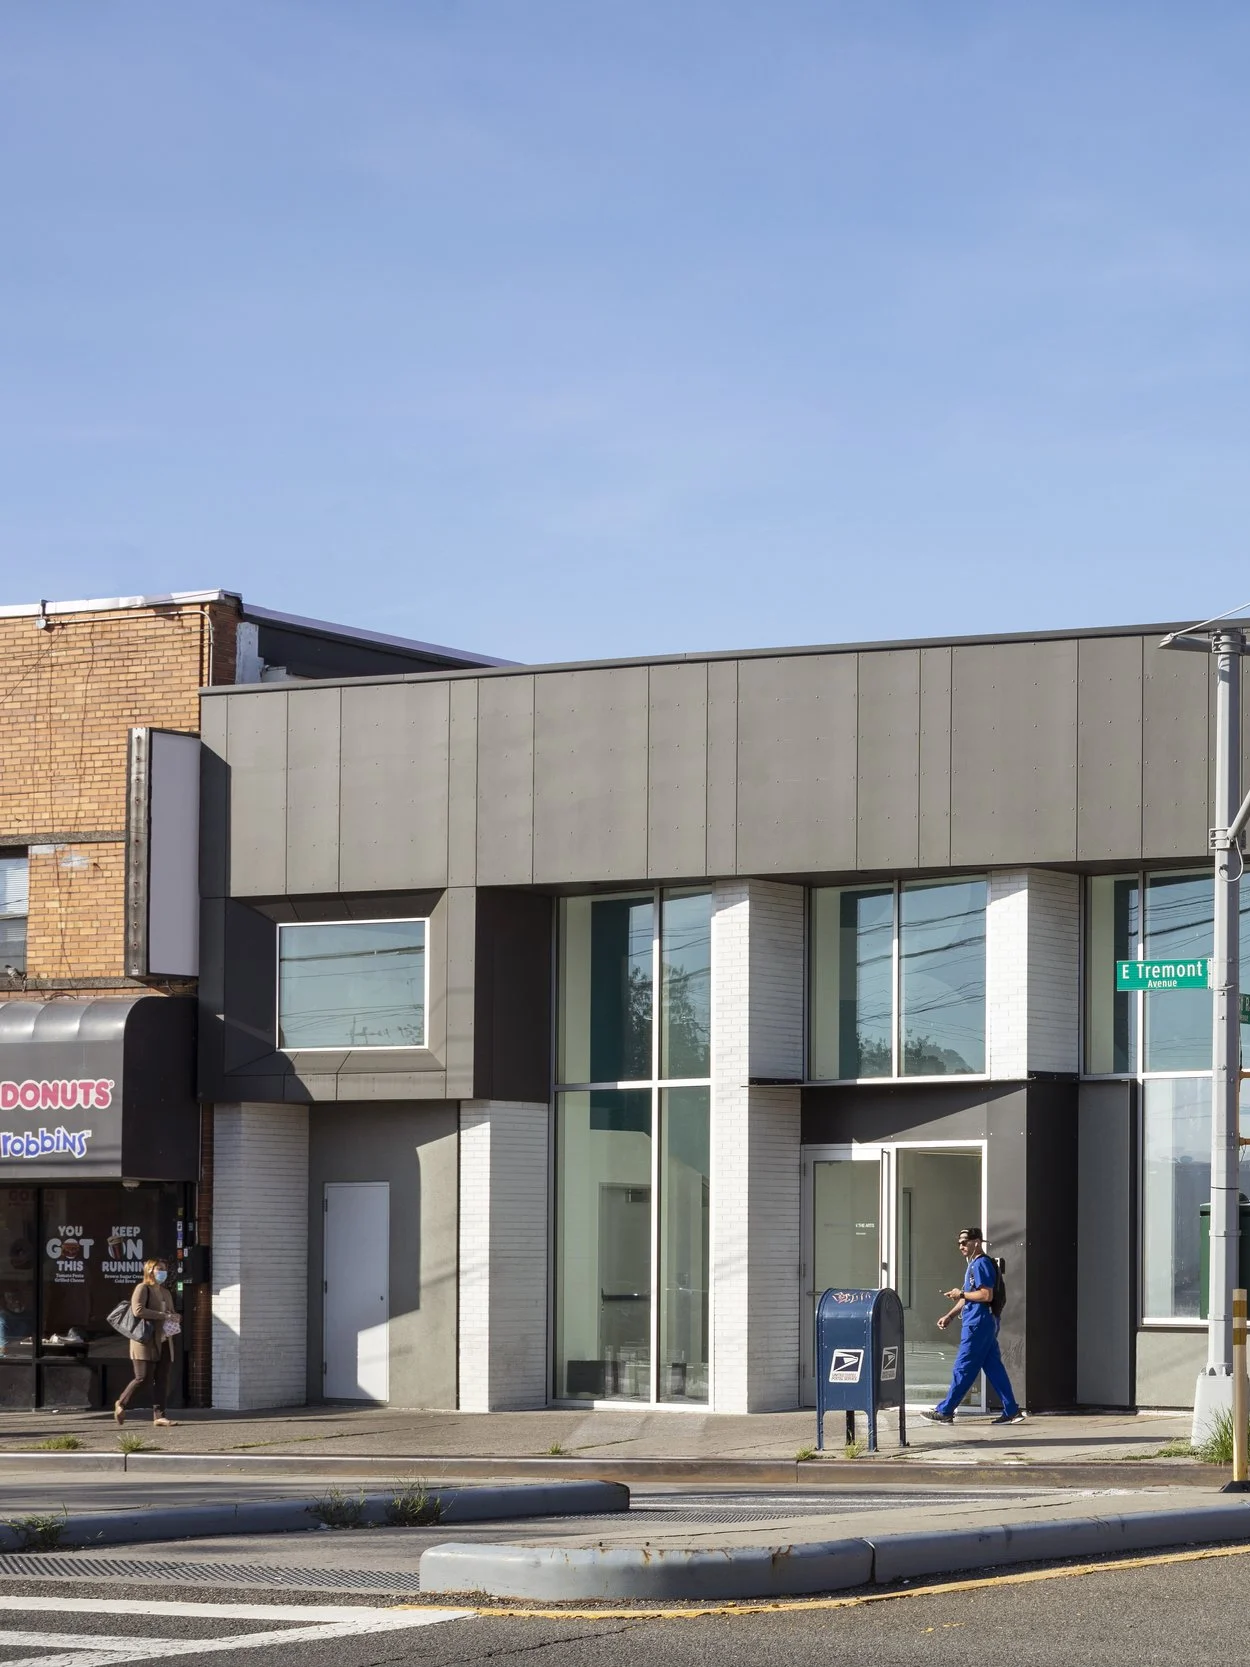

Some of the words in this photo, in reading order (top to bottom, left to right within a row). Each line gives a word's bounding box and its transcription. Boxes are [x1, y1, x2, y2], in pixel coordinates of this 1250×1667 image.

[1122, 964, 1130, 979] E
[1136, 961, 1203, 978] Tremont
[1147, 979, 1178, 988] Avenue
[0, 1080, 112, 1109] DONUTS
[58, 1225, 83, 1237] YOU
[111, 1226, 141, 1237] KEEP
[56, 1260, 84, 1272] THIS
